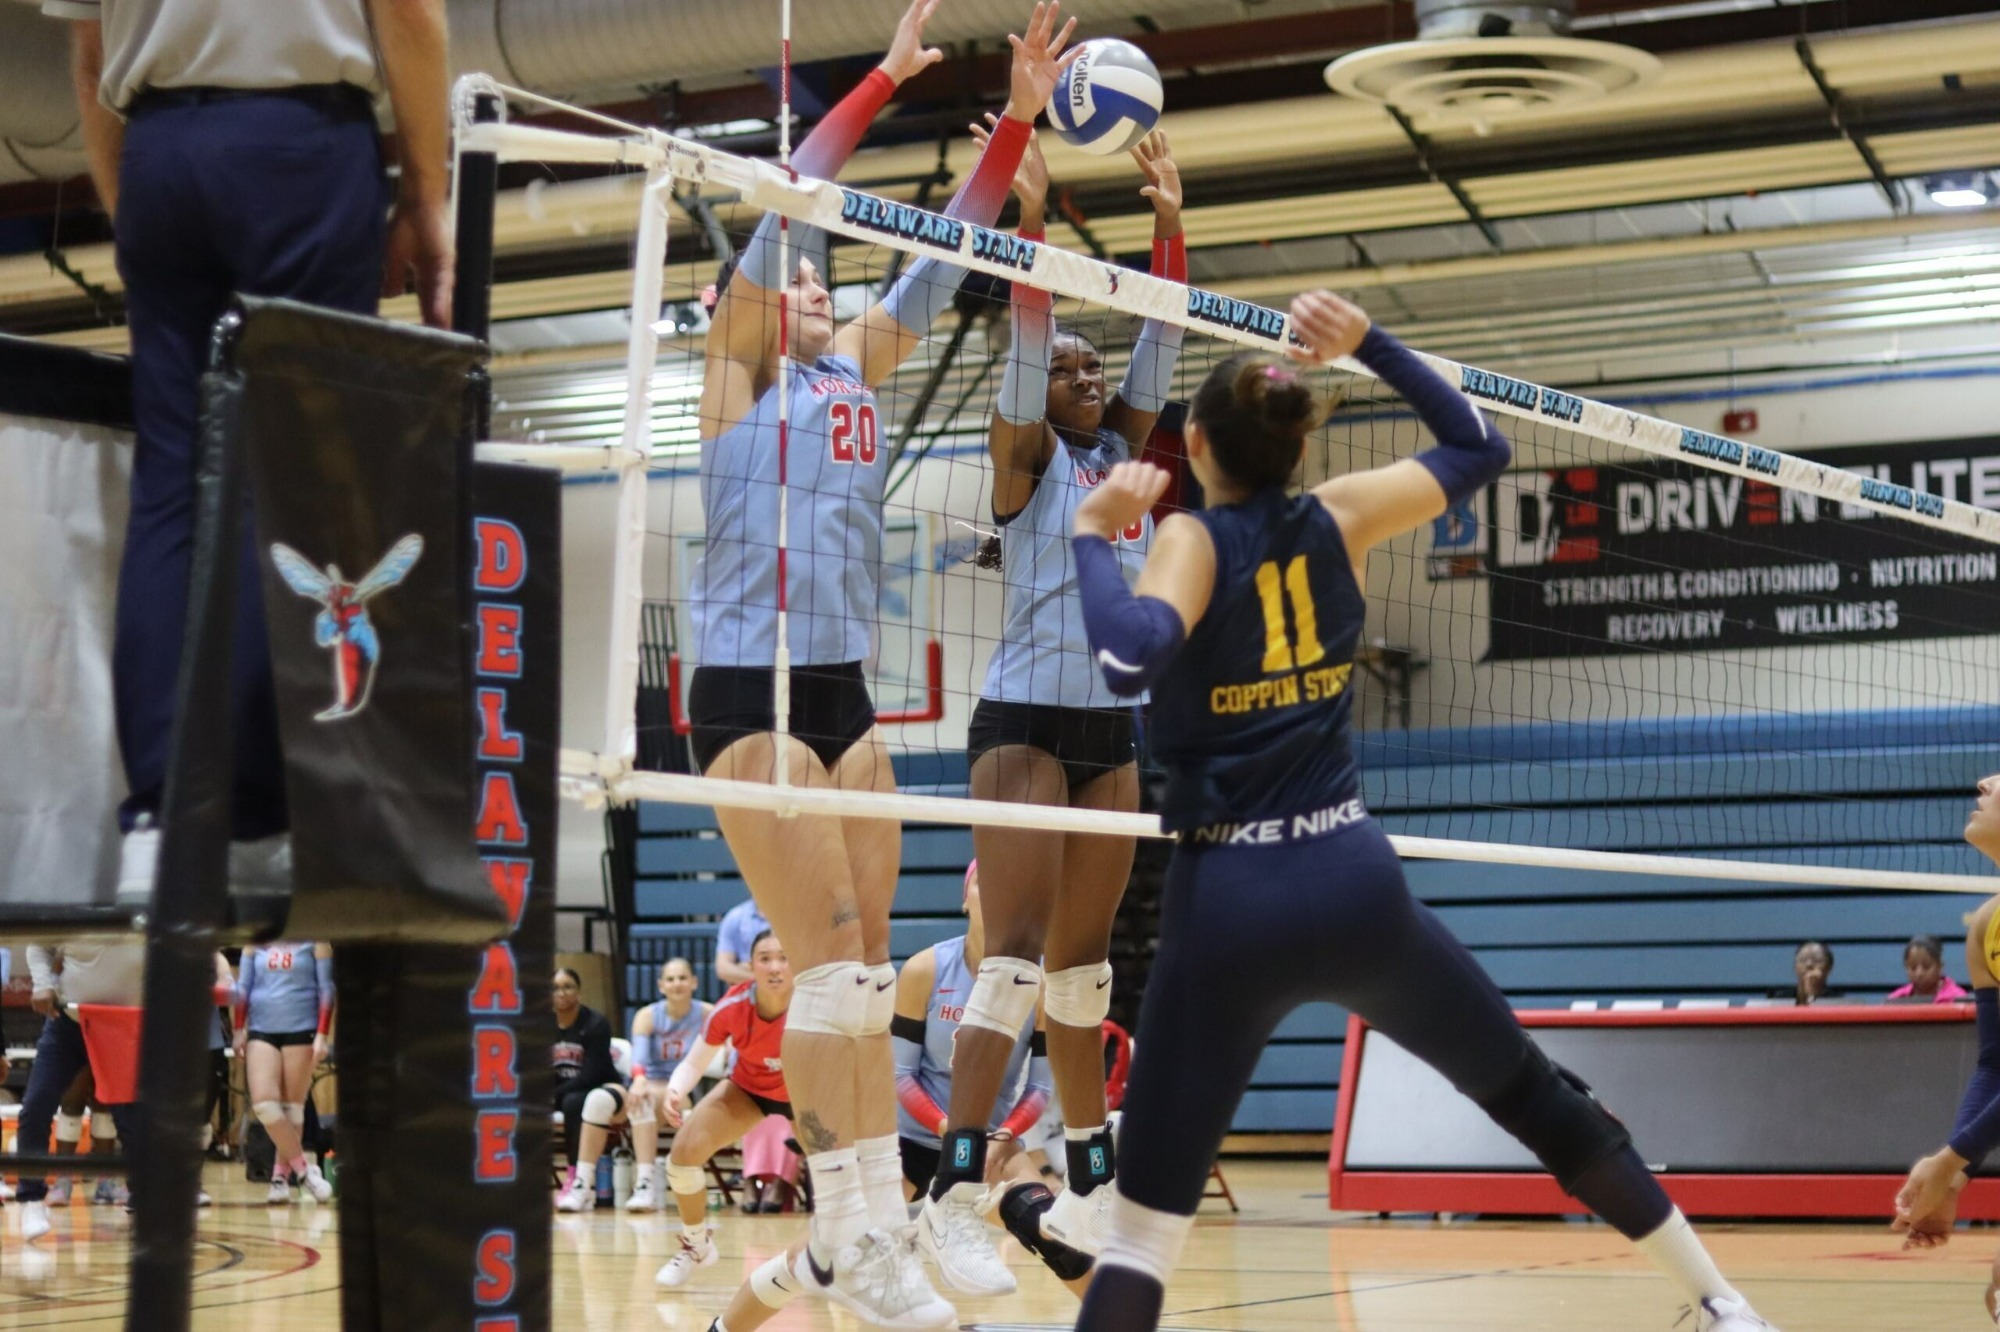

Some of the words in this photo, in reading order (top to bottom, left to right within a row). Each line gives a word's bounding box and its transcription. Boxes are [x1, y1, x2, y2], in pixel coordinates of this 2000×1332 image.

[841, 190, 965, 253] DELAWARE
[972, 226, 1036, 272] STATE
[1187, 288, 1285, 341] DELAWARE
[1461, 366, 1538, 411] DELAWARE
[1541, 389, 1583, 424] STATE
[830, 401, 877, 465] 20
[1615, 475, 1818, 535] DRIVEN
[1871, 552, 1997, 588] NUTRITION
[1255, 554, 1325, 672] 11
[1607, 609, 1724, 642] RECOVERY
[1776, 600, 1899, 635] WELLNESS
[1211, 674, 1299, 713] COPPIN
[1195, 819, 1285, 845] NIKE
[1293, 799, 1366, 838] NIKE
[473, 1228, 519, 1332] S
